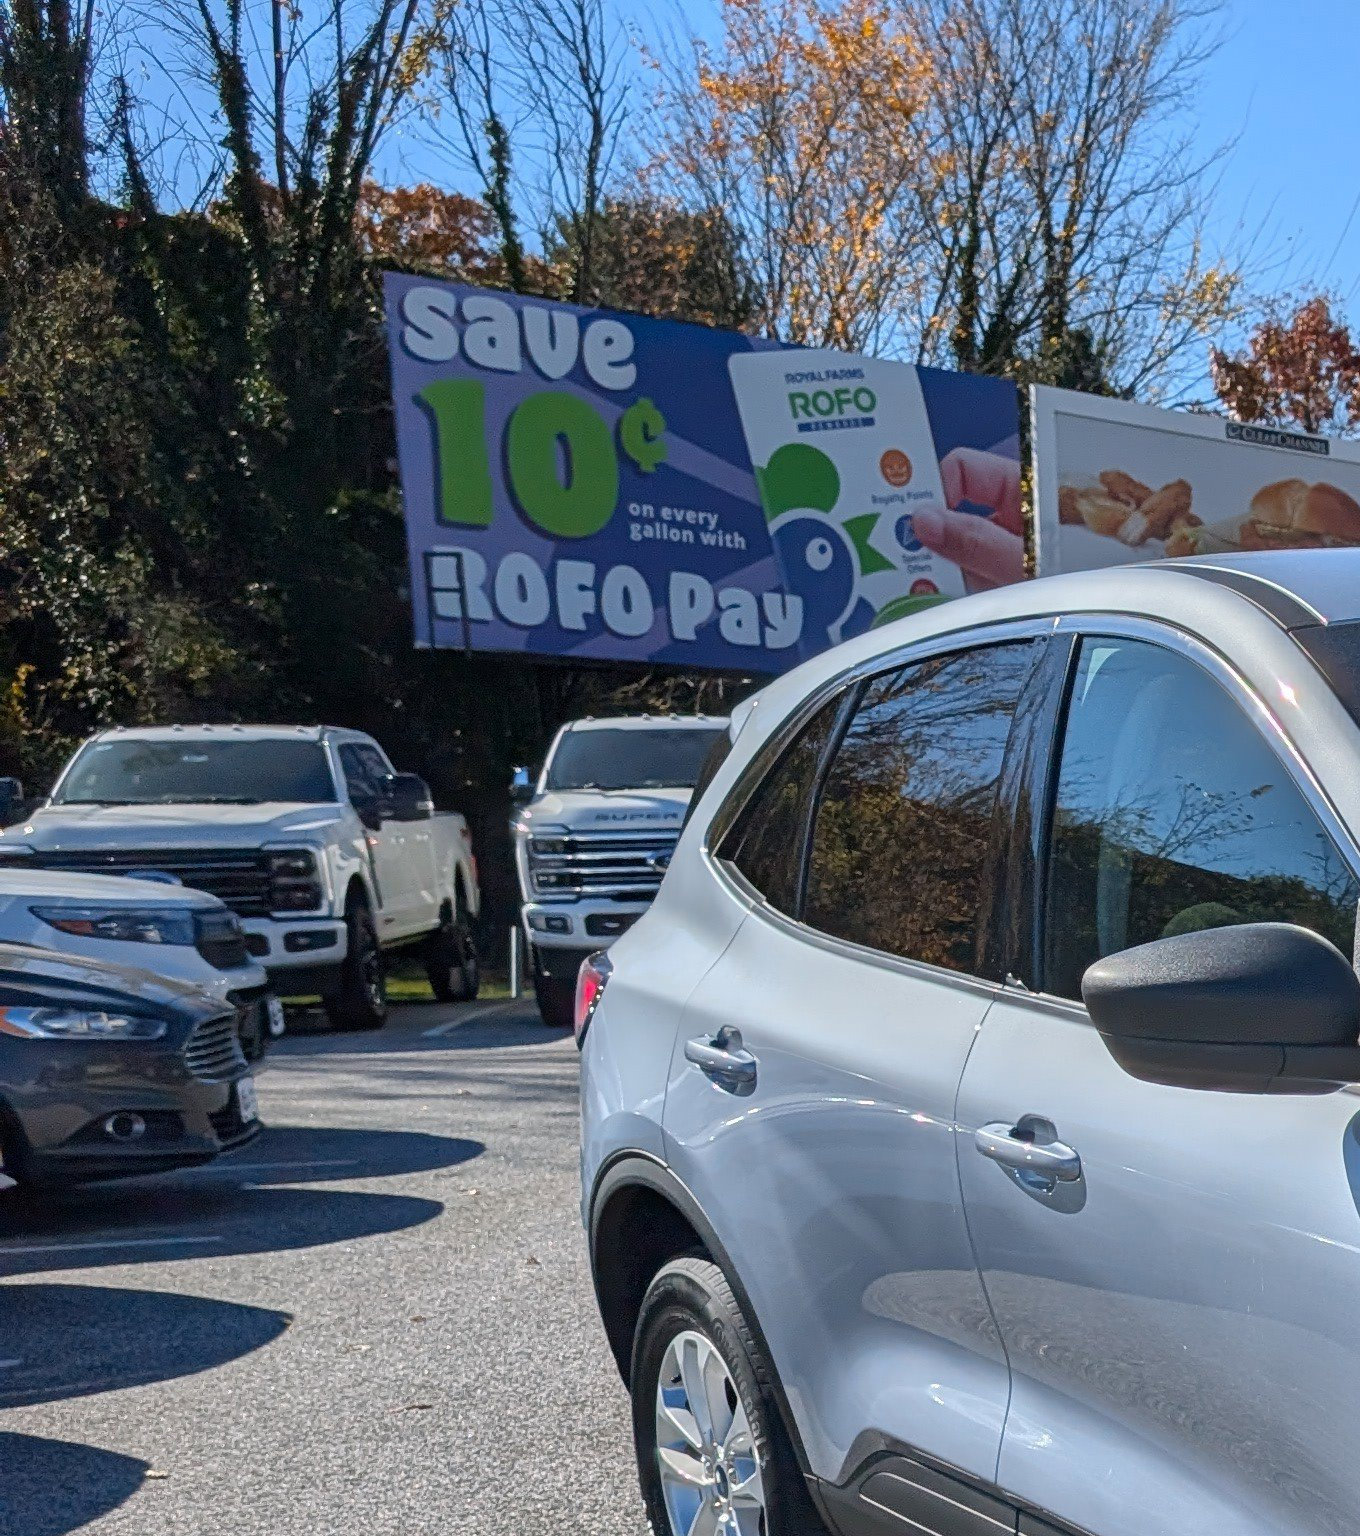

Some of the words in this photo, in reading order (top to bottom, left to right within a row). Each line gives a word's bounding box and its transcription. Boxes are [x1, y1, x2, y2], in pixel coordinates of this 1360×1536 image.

[787, 386, 877, 419] ROFO
[628, 502, 655, 519] on
[661, 506, 719, 531] every
[630, 521, 695, 544] gallon
[699, 529, 747, 551] with
[430, 545, 653, 637] ROFO
[668, 571, 804, 649] Pay
[595, 812, 680, 821] SUPER
